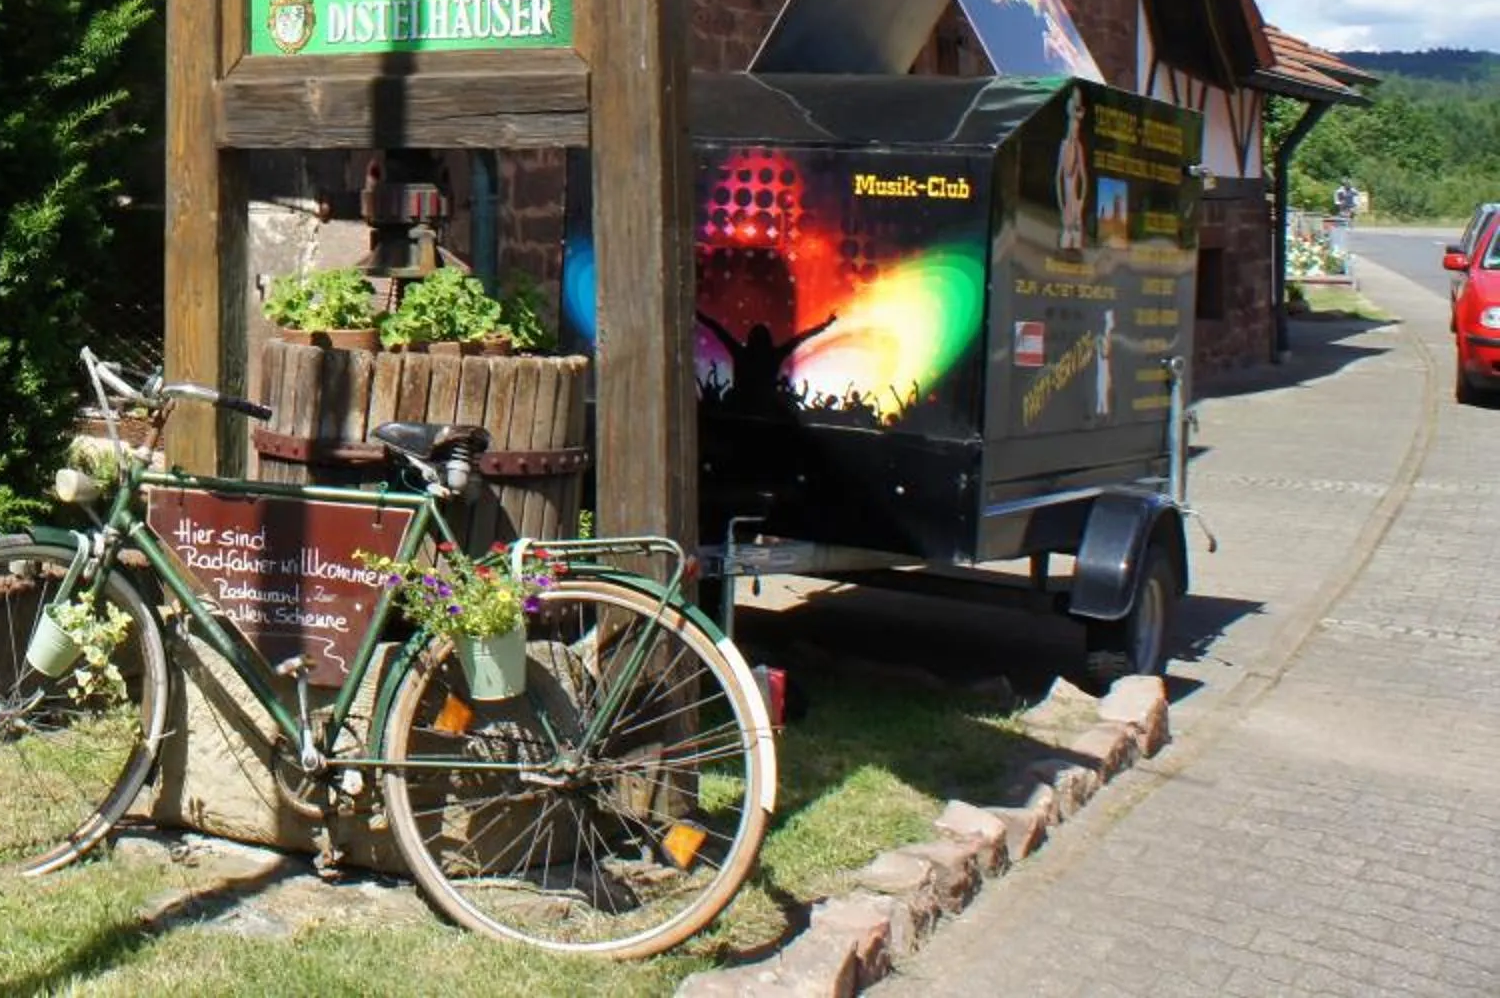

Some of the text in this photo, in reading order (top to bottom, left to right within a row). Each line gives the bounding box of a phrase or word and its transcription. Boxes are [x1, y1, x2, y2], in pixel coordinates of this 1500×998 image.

[853, 173, 971, 200] Musik-Club
[174, 517, 265, 550] Hier sind
[175, 545, 276, 578] Radfahrer
[275, 605, 350, 633] Scheune
